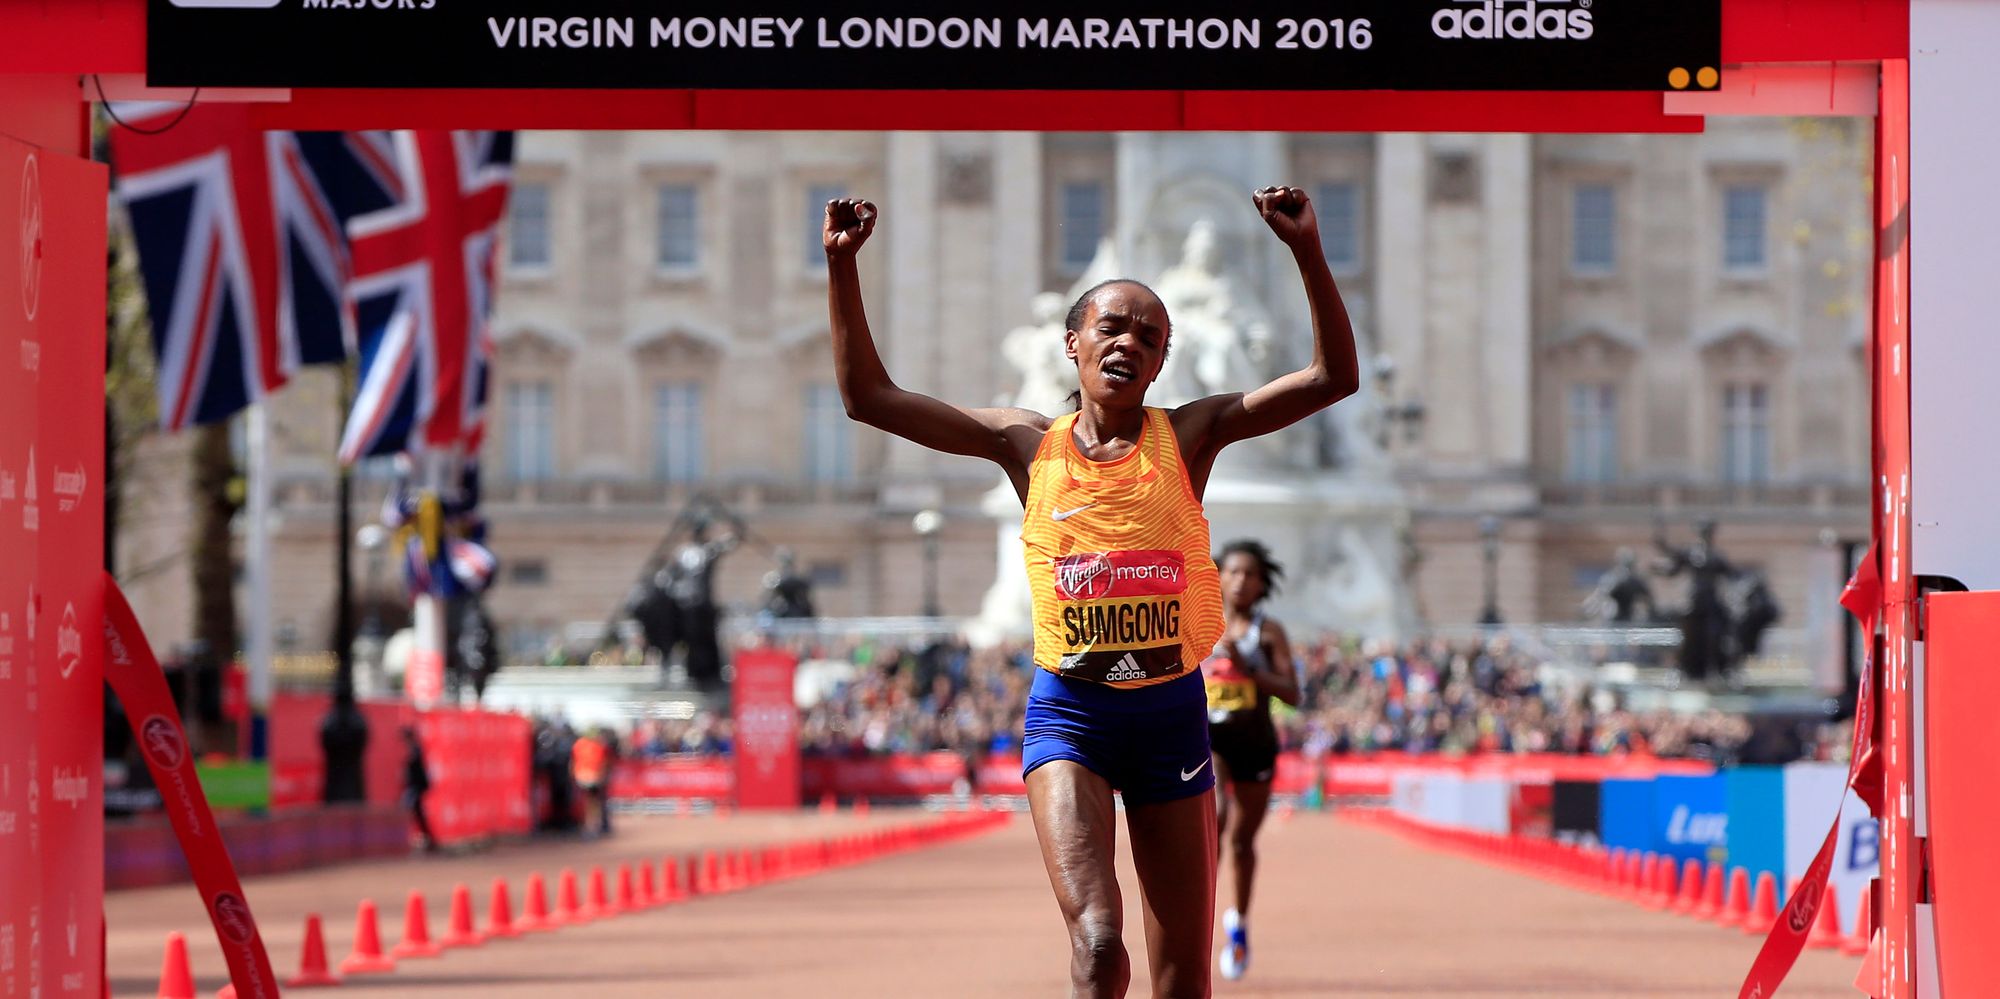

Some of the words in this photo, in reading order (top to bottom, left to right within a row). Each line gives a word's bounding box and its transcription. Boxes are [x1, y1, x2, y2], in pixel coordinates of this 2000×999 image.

[488, 16, 634, 49] VIRGIN
[650, 16, 803, 49] MONEY
[818, 17, 1002, 49] LONDON
[1017, 17, 1261, 50] MARATHON
[1275, 18, 1373, 50] 2016
[1431, 1, 1594, 40] adidas
[1062, 558, 1109, 594] Virgin
[1116, 563, 1180, 583] money
[1063, 599, 1180, 647] SUMGONG
[1106, 665, 1147, 682] adidas
